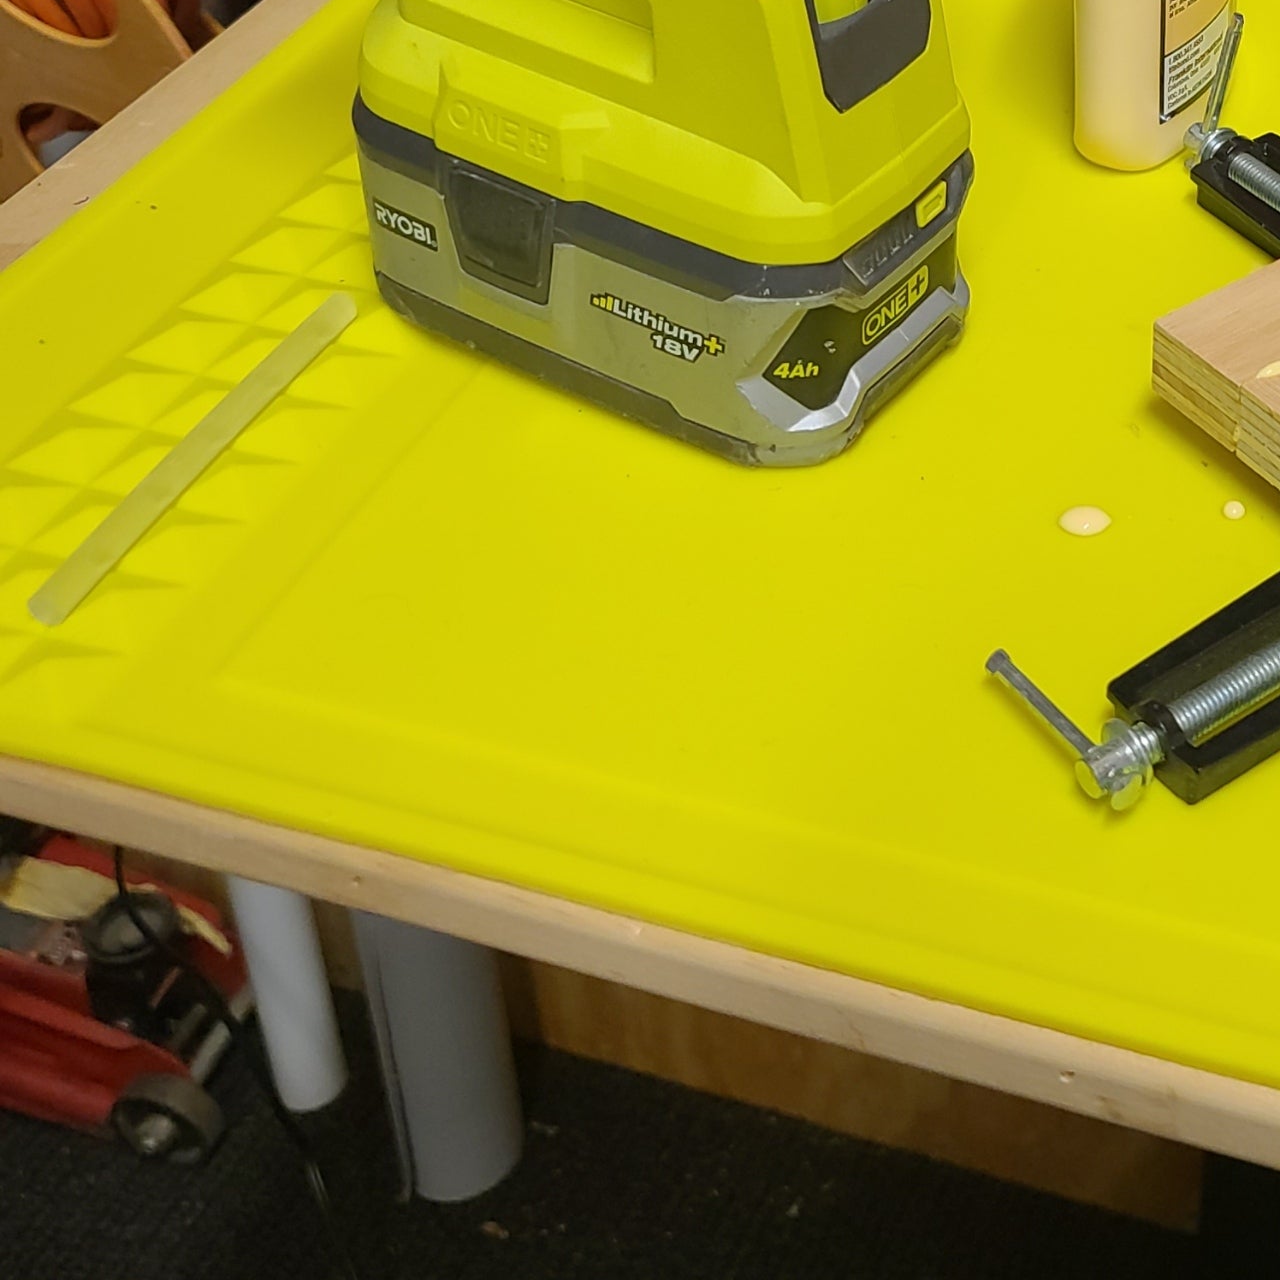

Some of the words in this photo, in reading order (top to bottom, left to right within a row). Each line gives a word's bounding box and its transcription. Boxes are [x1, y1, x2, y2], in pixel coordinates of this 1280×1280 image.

[374, 202, 432, 245] RYOBI
[652, 334, 700, 361] 18V
[773, 361, 819, 379] 4Ah
